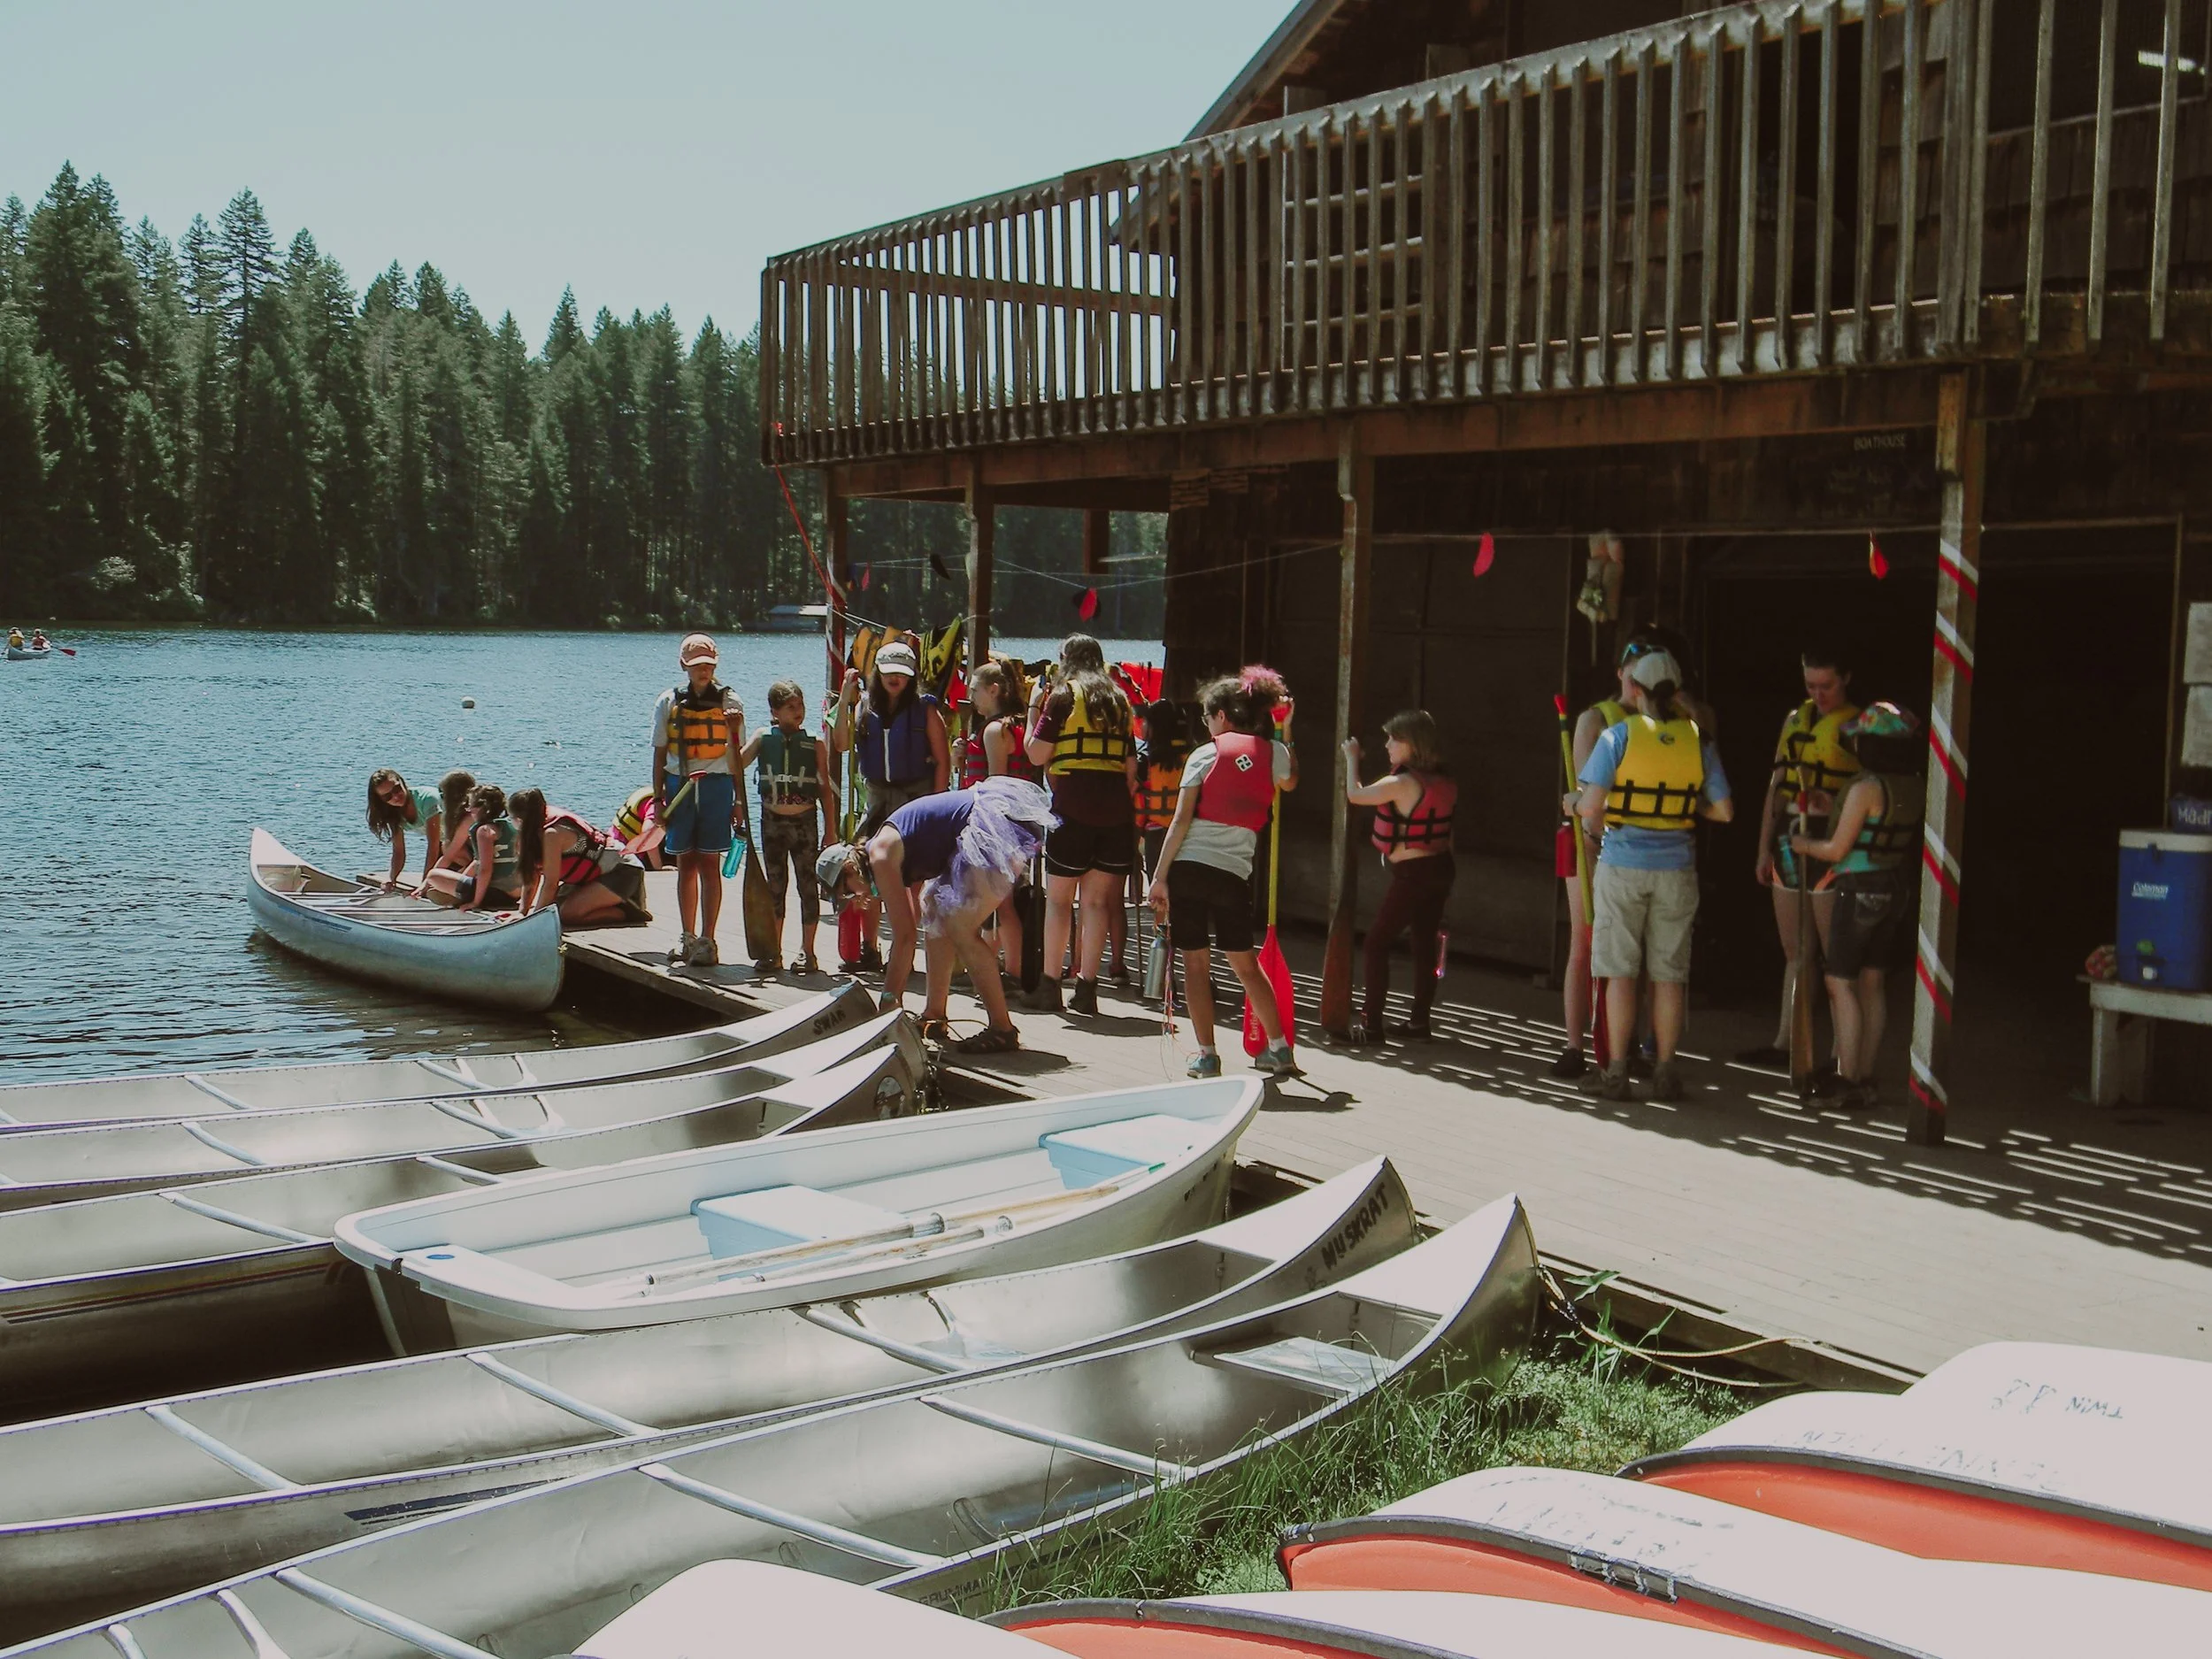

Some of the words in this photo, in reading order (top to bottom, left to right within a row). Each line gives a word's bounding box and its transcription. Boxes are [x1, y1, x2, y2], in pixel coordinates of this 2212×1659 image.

[2132, 881, 2169, 896] Coleman
[1321, 1181, 1390, 1271] MUSKRAT
[2064, 1395, 2124, 1419] TWIN
